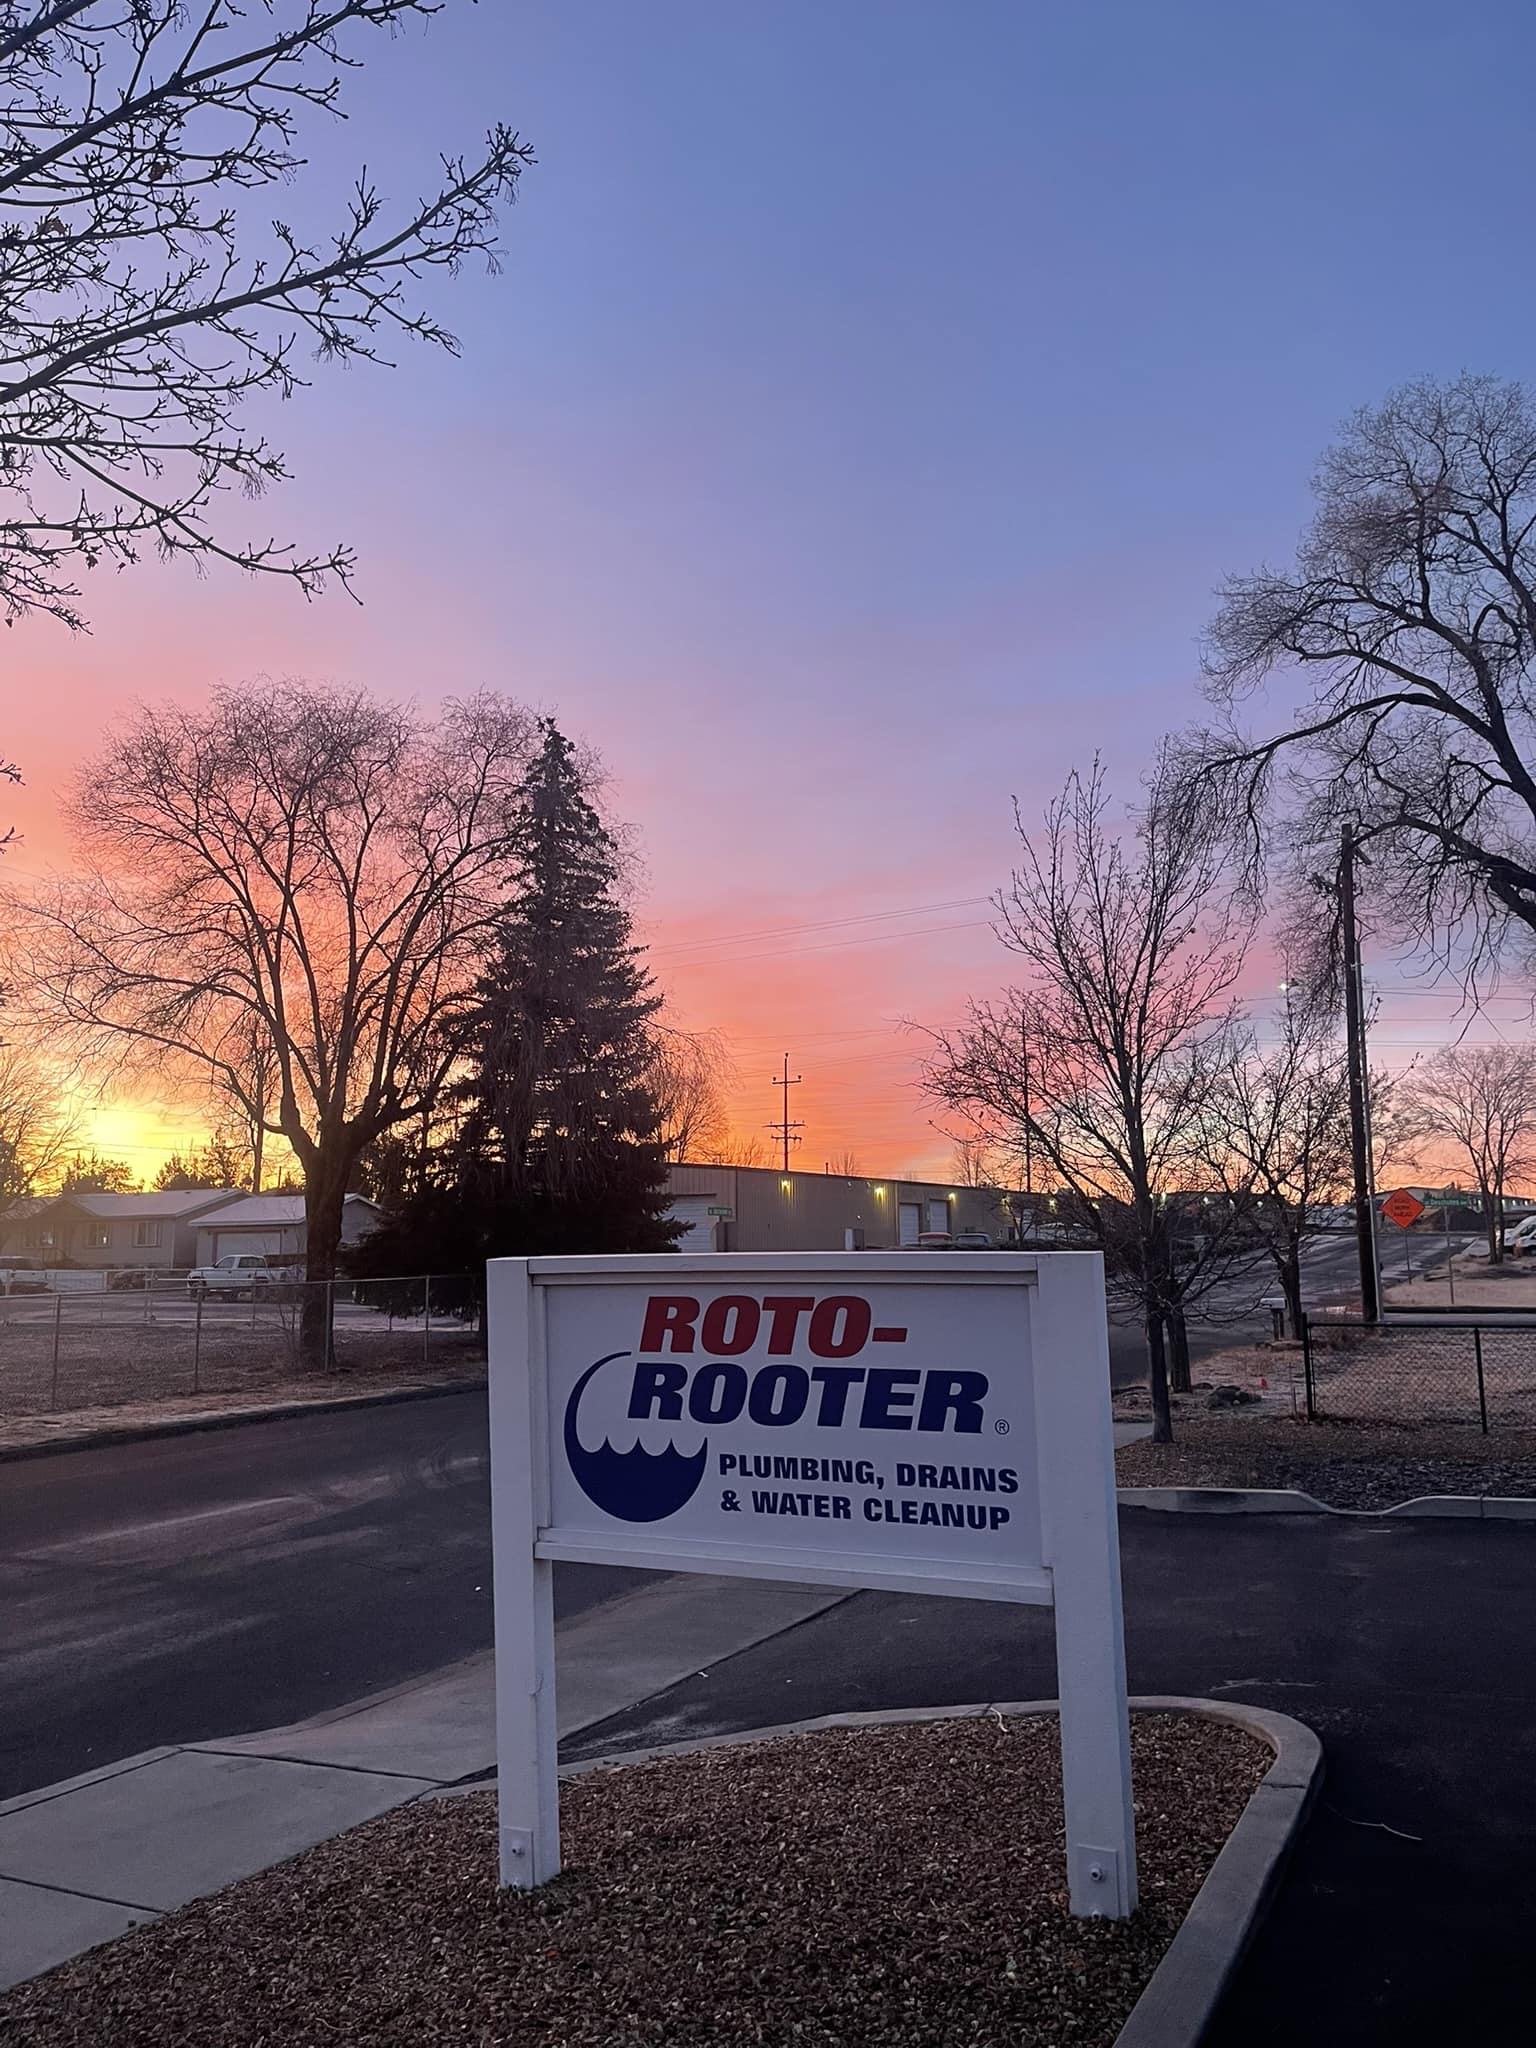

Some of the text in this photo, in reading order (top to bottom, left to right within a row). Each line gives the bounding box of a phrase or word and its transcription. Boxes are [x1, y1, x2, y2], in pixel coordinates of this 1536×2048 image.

[640, 1295, 907, 1358] ROTO-
[628, 1363, 988, 1433] ROOTER
[720, 1454, 1018, 1493] PLUMBING, DRAINS
[721, 1490, 1009, 1530] & WATER CLEANUP
